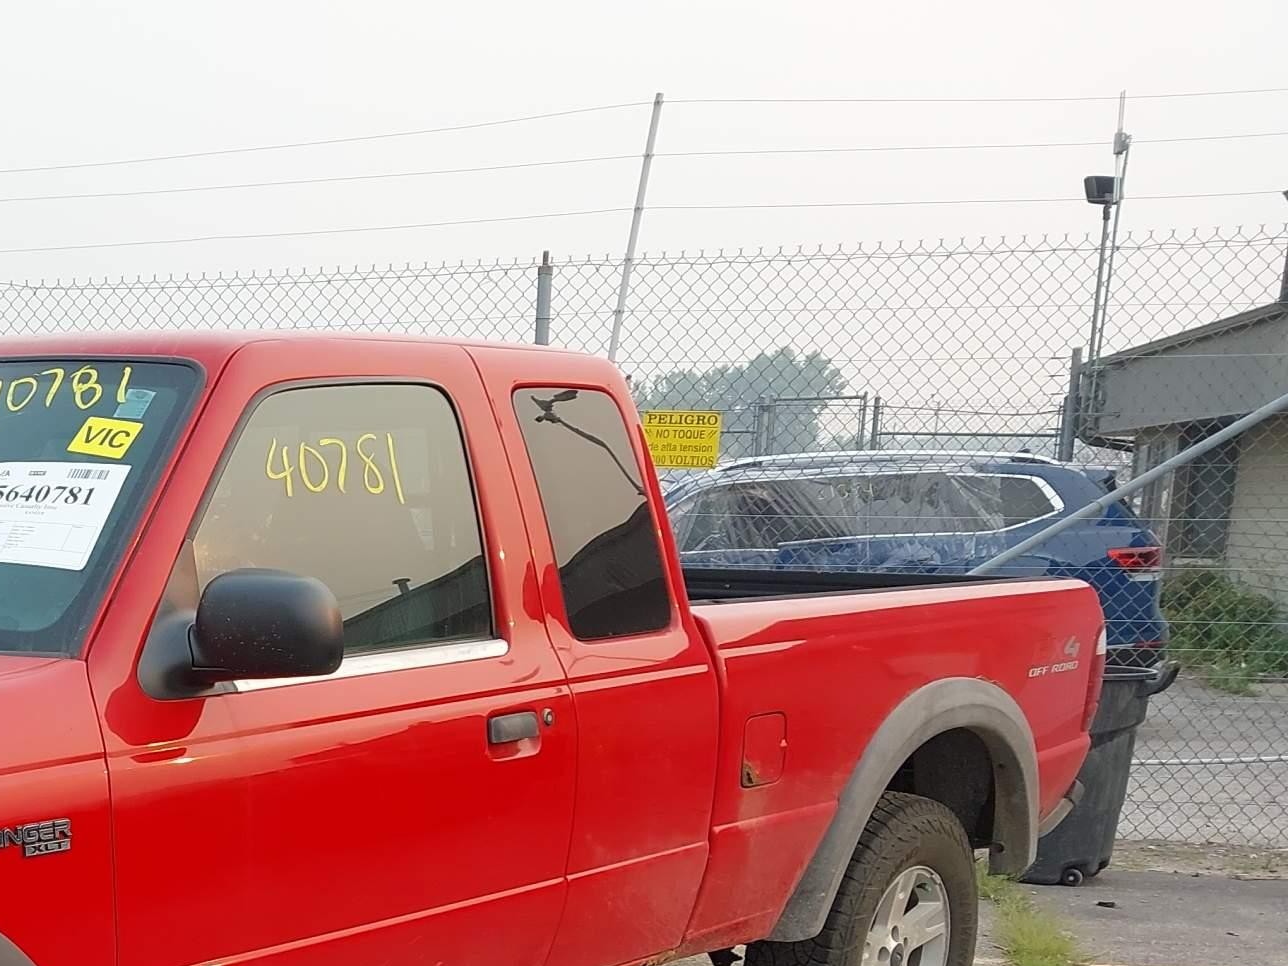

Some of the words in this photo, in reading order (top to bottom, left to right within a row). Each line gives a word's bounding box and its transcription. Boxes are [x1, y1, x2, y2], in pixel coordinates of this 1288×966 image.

[647, 414, 718, 425] PELIGRO
[82, 425, 131, 449] VIC
[655, 429, 670, 439] NO
[673, 429, 706, 440] TOQUE
[669, 455, 715, 466] VOLTIOS
[265, 432, 405, 504] 40781
[1028, 665, 1050, 678] OFF
[1051, 660, 1079, 673] ROAD
